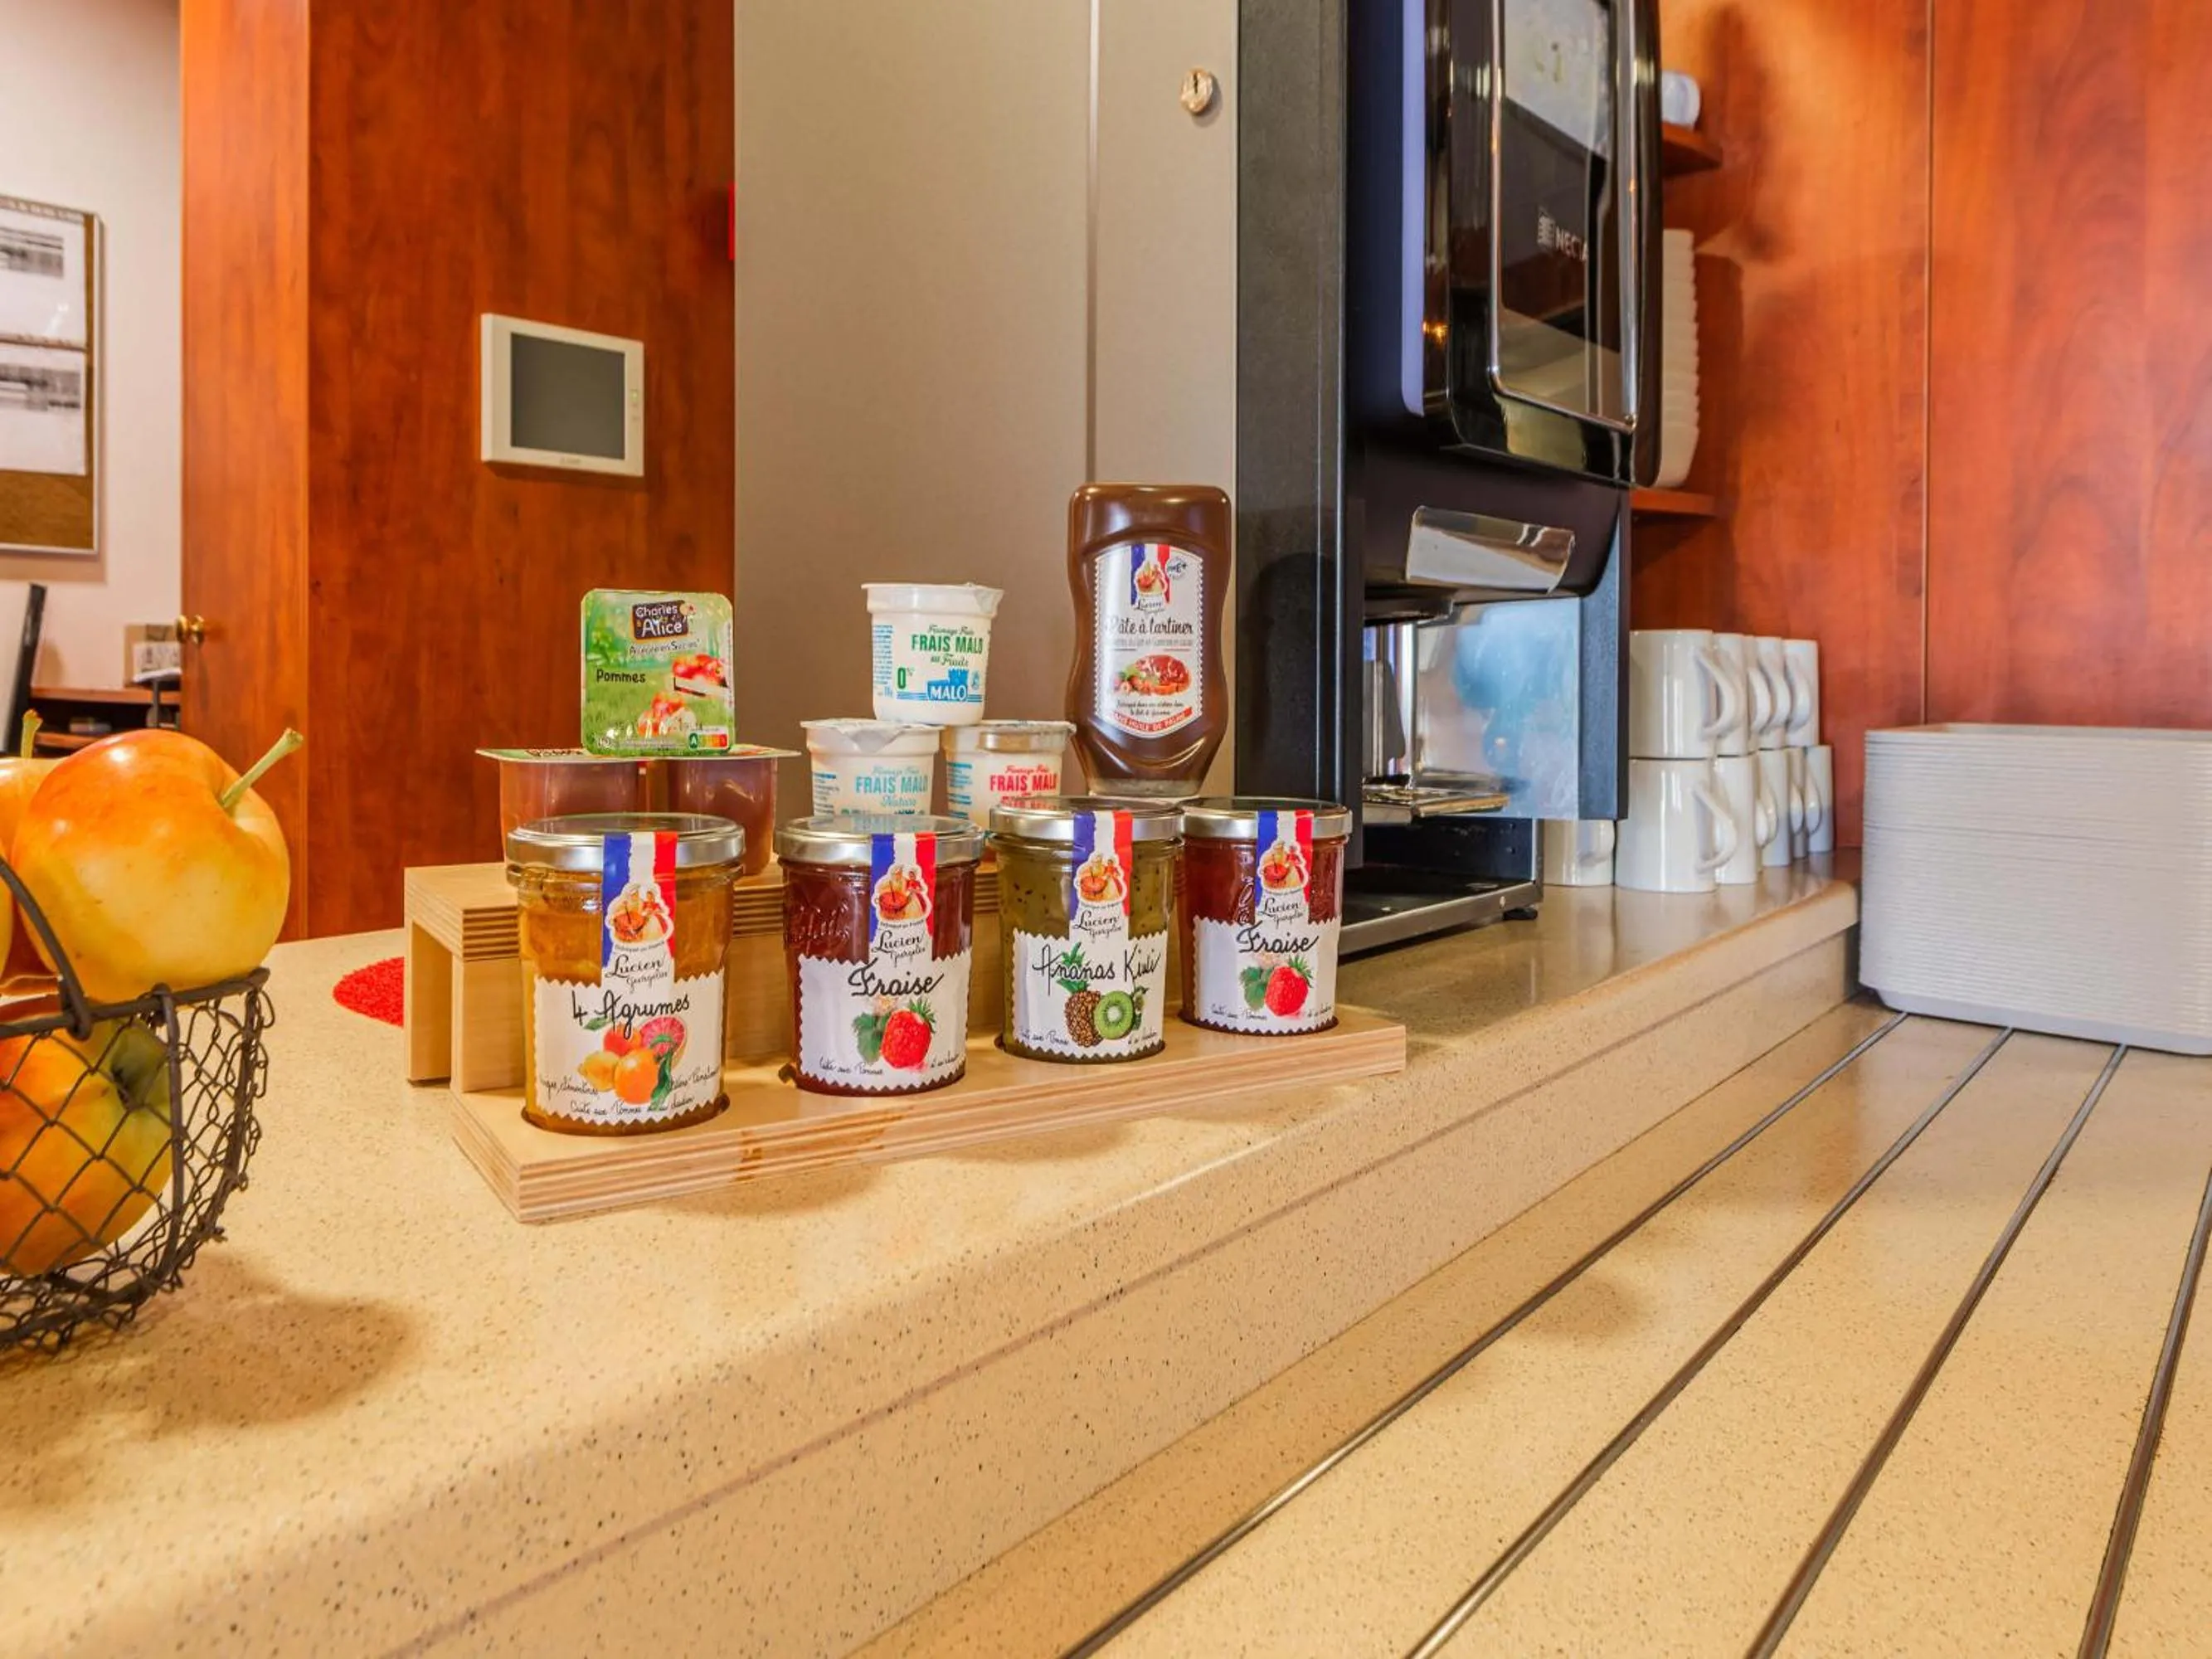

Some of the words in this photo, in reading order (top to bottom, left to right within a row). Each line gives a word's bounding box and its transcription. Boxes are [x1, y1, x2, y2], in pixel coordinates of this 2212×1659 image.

[635, 605, 678, 617] Charles
[641, 618, 683, 637] Alice
[1150, 617, 1193, 635] tartiner
[912, 635, 950, 652] FRAIS
[955, 636, 983, 654] MALO
[596, 669, 646, 684] Pommes
[930, 685, 966, 700] MALO
[856, 776, 896, 794] FRAIS
[990, 775, 1028, 791] FRAIS
[871, 930, 922, 954] Lucien
[1236, 921, 1319, 953] Fraise
[605, 954, 664, 979] Lucien
[1032, 944, 1116, 995] Ananas
[848, 957, 945, 997] Fraise
[571, 990, 588, 1026] 4
[594, 990, 690, 1039] Agrumes
